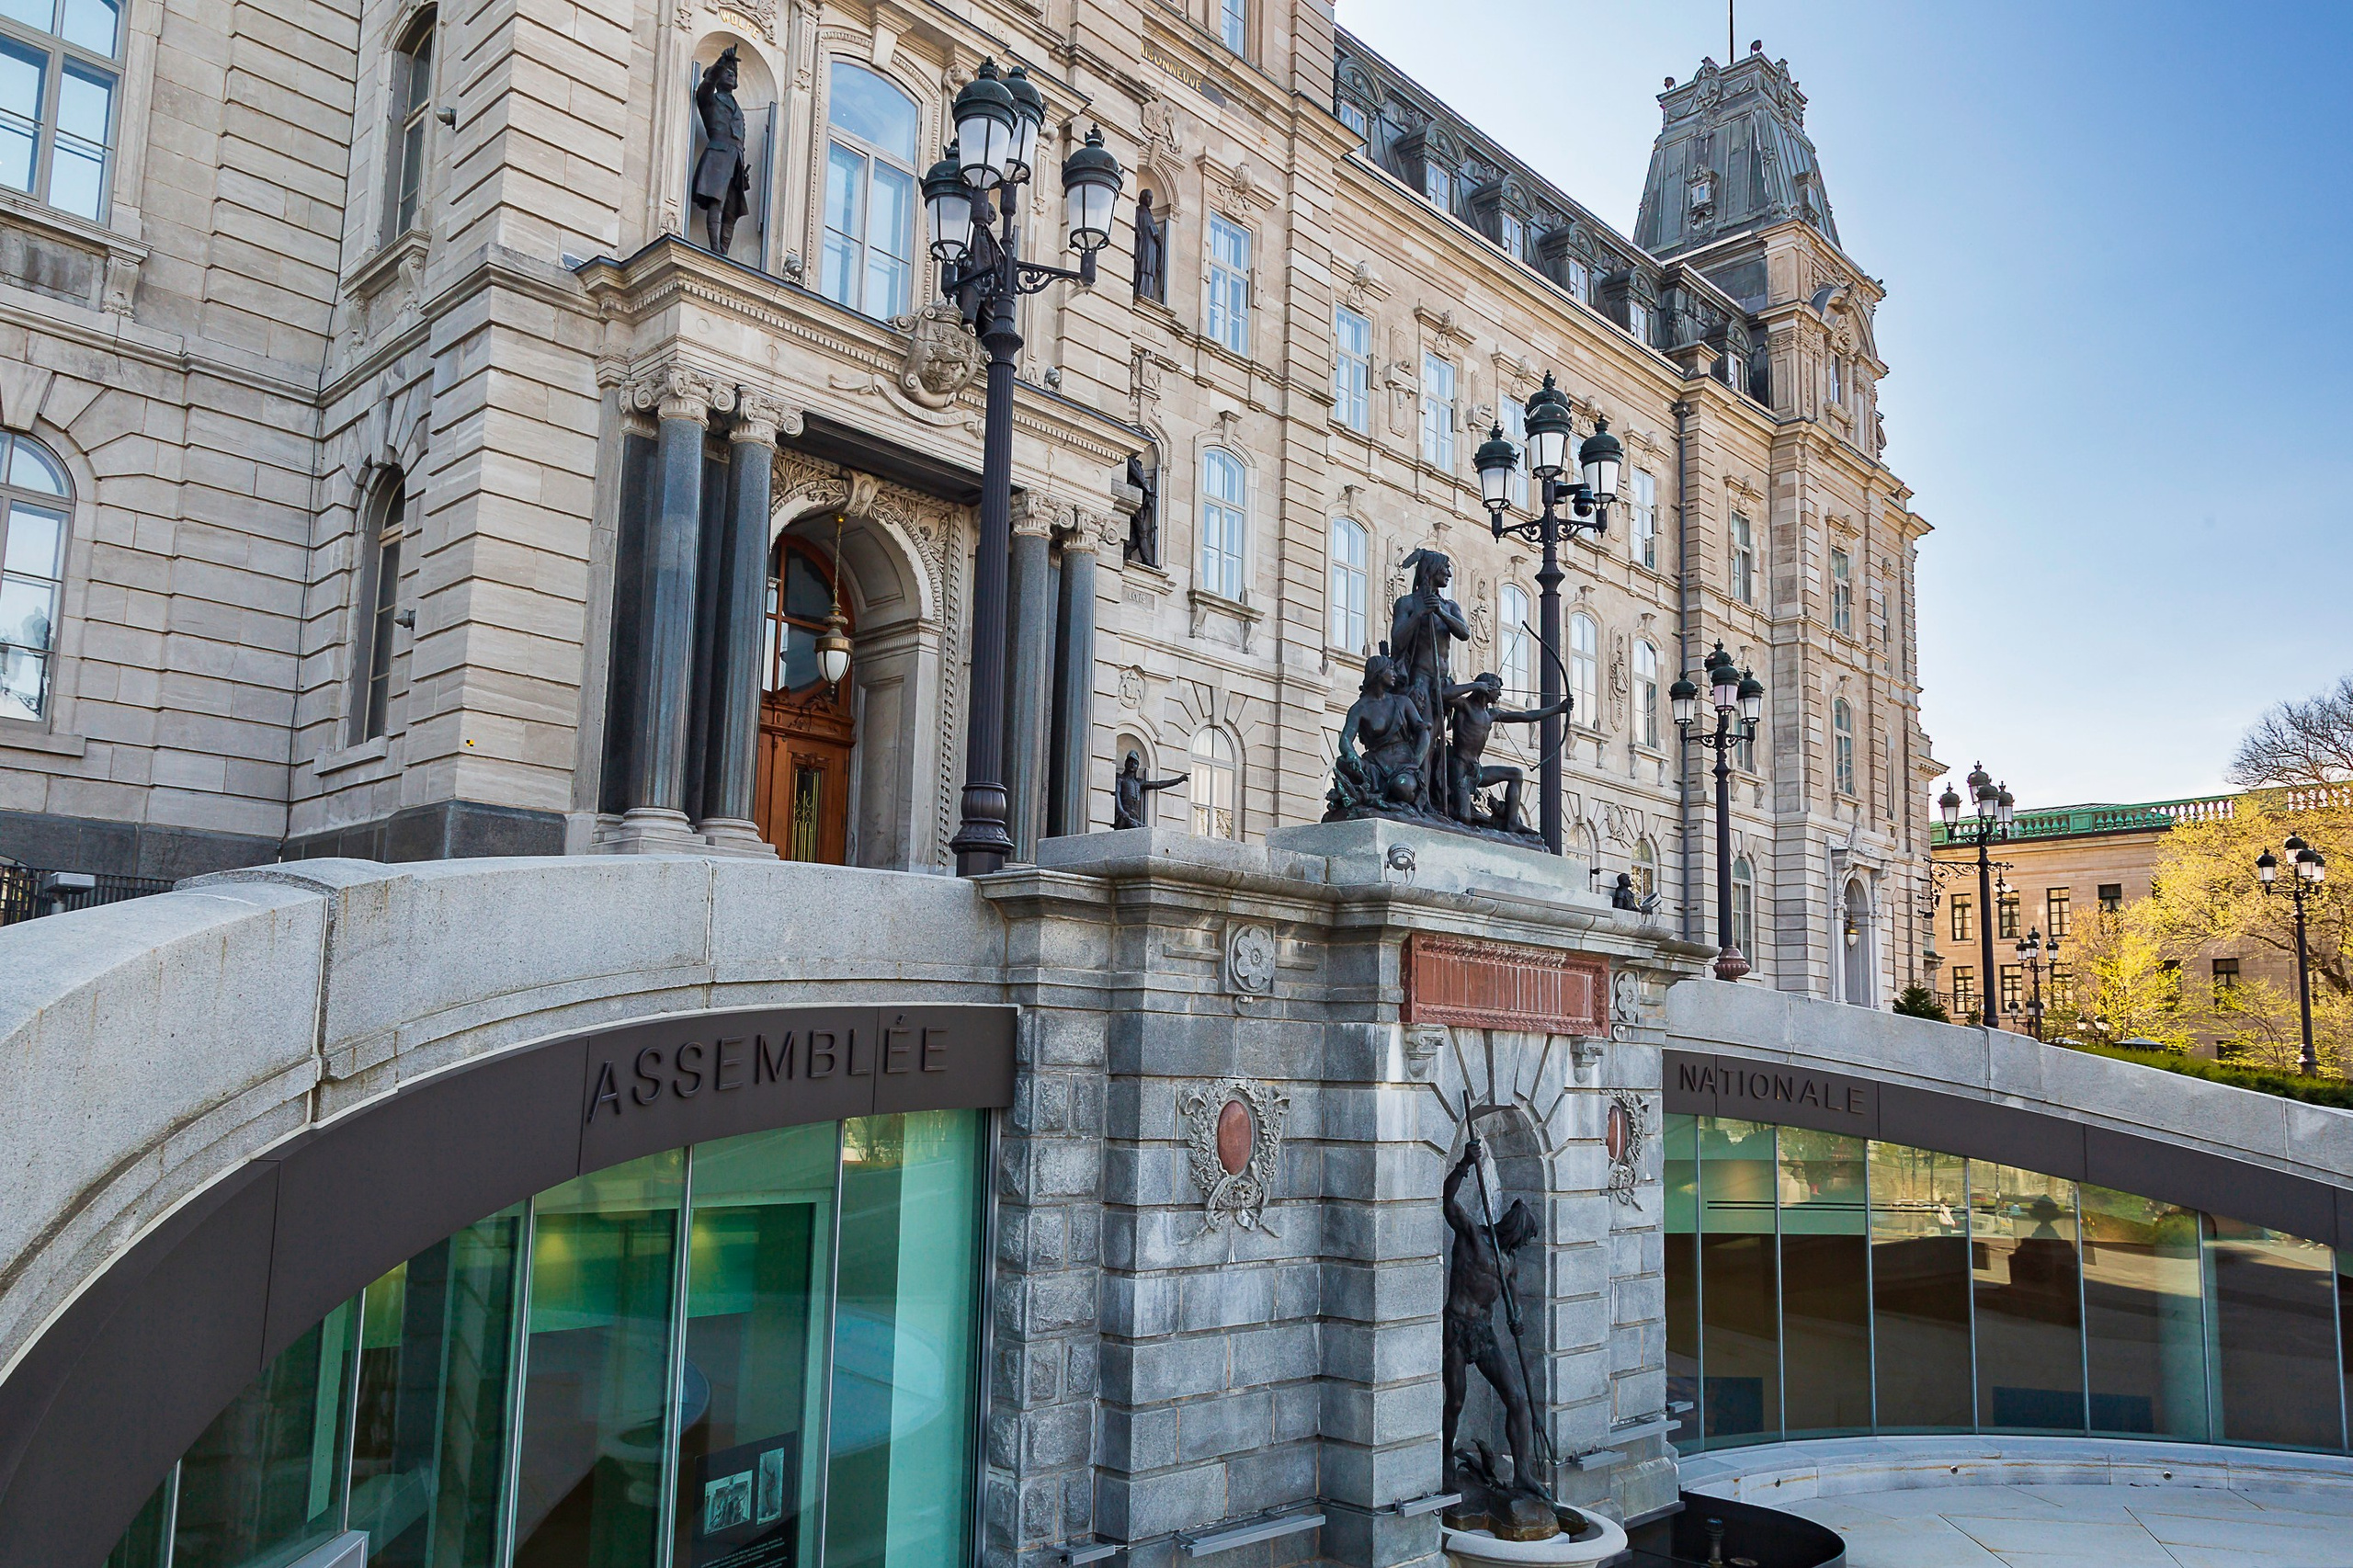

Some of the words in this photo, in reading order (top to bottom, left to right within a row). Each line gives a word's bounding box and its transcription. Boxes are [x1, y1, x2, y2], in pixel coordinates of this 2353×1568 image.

[720, 8, 760, 40] WOLFE
[1141, 42, 1202, 92] AISONNEUVE
[587, 1015, 950, 1123] ASSEMBLÉE
[1680, 1062, 1866, 1115] NATIONALE
